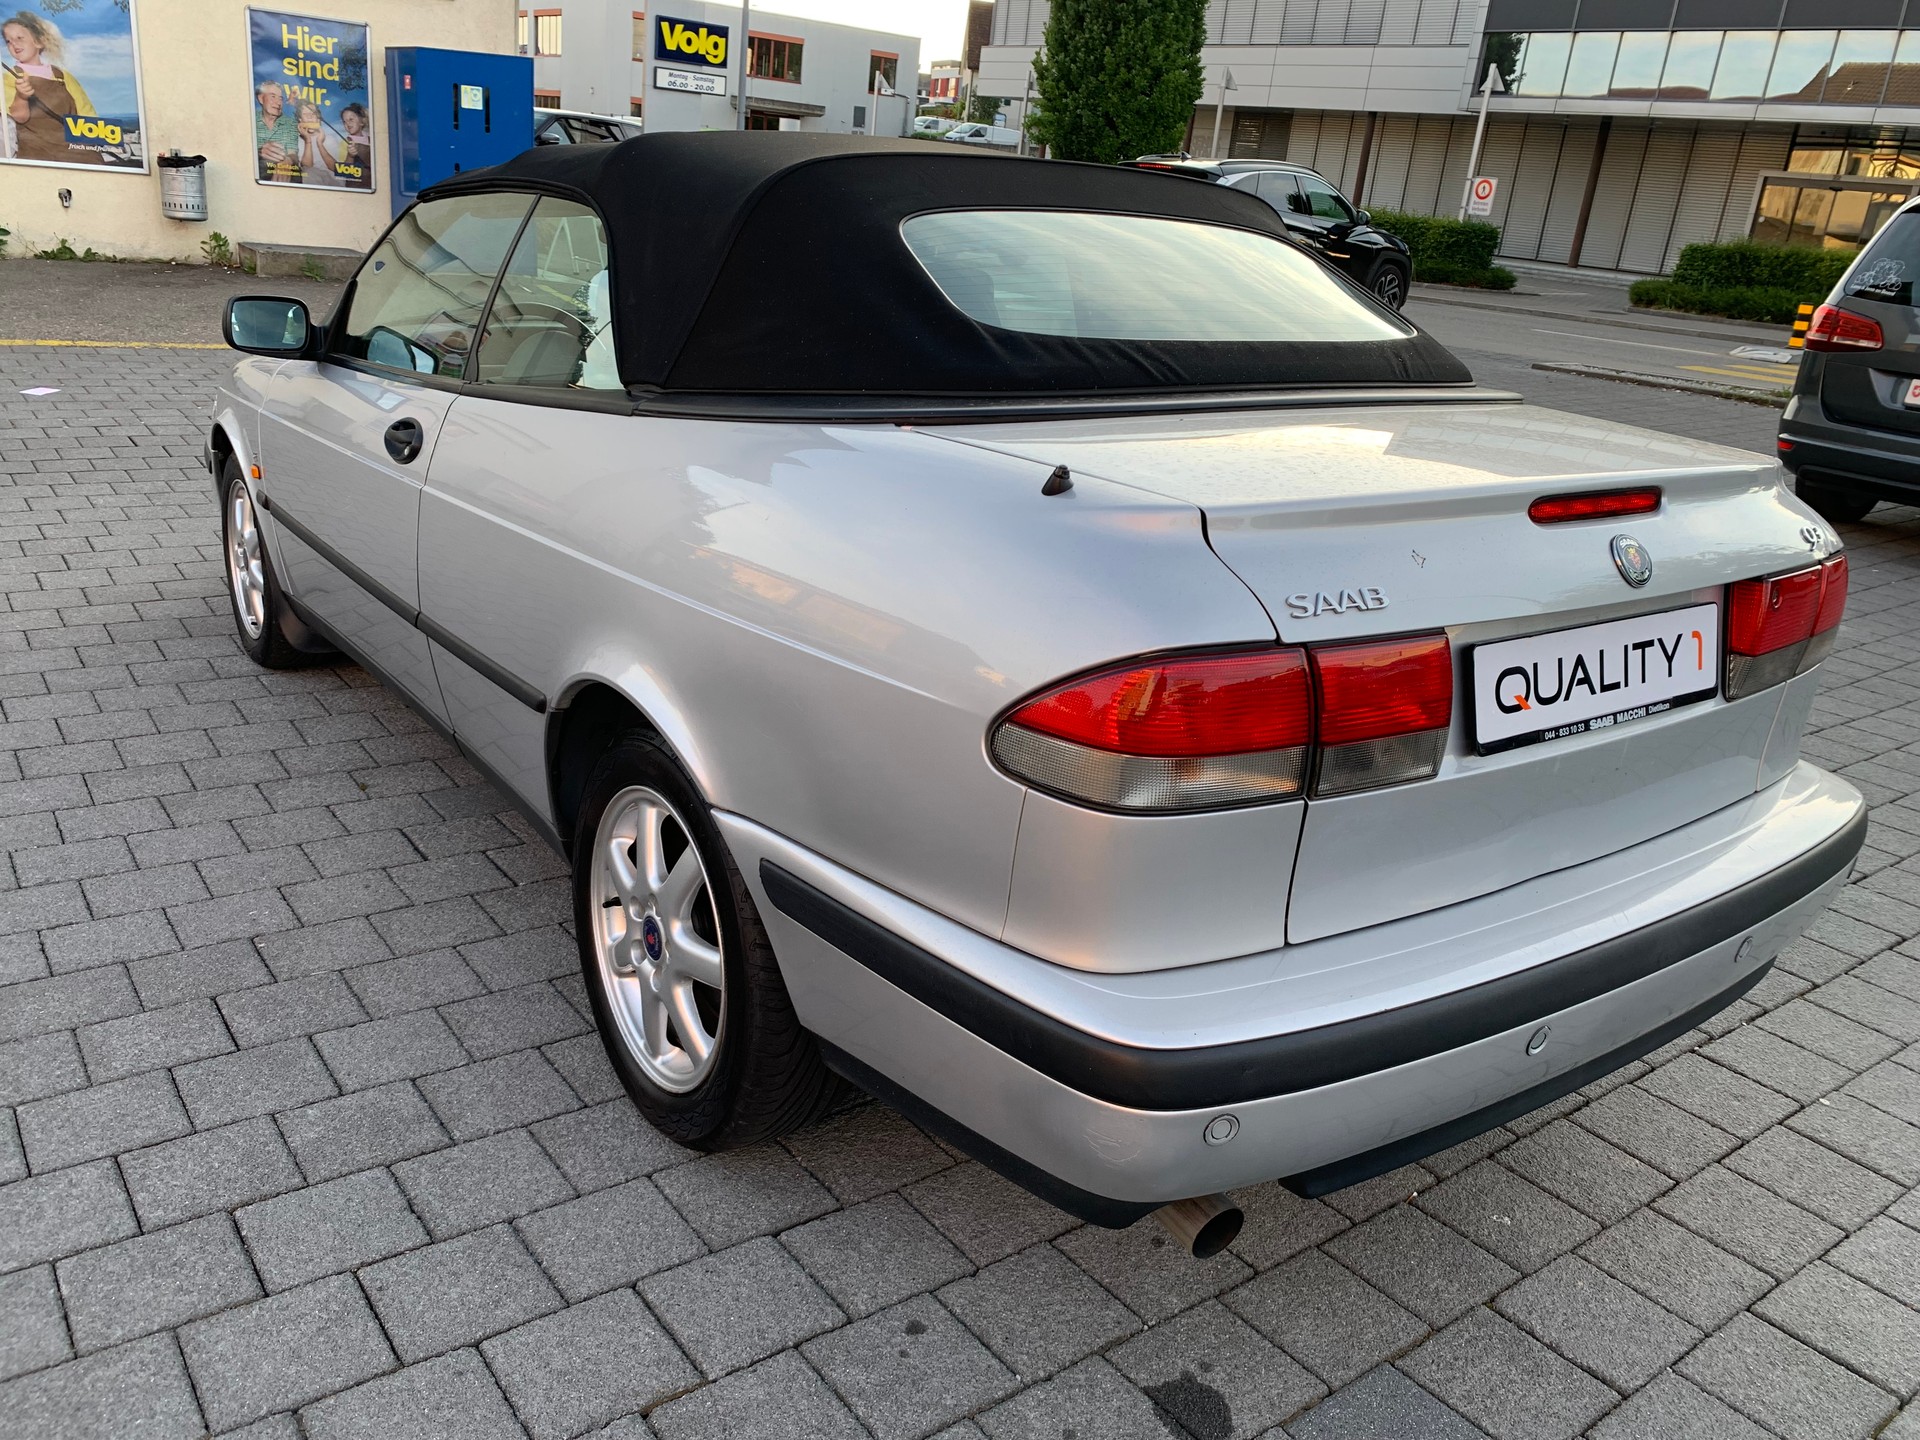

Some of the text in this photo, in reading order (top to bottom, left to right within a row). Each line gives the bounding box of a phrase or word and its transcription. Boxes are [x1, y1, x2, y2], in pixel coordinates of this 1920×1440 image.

[281, 23, 338, 54] Hier
[660, 21, 726, 65] Volg
[282, 52, 340, 81] sind
[668, 72, 688, 81] Montag
[283, 79, 331, 106] wir.
[667, 80, 688, 88] 06.00
[694, 84, 715, 92] 20.00
[65, 117, 122, 144] Volg
[335, 163, 362, 177] Volg
[1285, 586, 1390, 619] SAAB
[1494, 633, 1684, 715] QUALITY
[1544, 730, 1556, 740] 044
[1559, 727, 1570, 737] 833
[1570, 725, 1578, 734] 10
[1577, 723, 1585, 732] 33
[1589, 715, 1614, 730] SAAB
[1616, 707, 1646, 723] MACCHI
